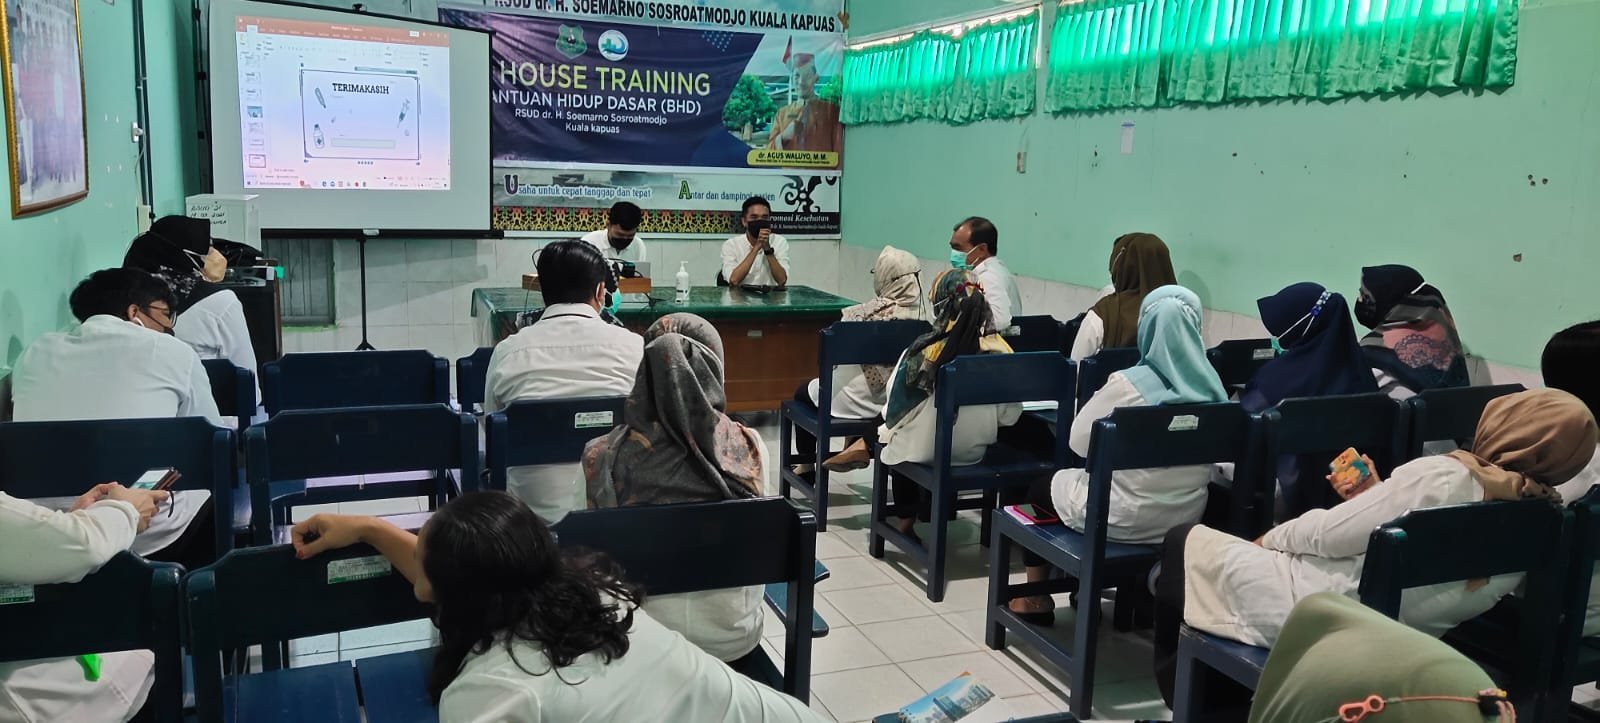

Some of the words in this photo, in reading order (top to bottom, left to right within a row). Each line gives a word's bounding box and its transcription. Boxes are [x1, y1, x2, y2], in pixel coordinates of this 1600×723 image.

[556, 0, 569, 12] H.
[573, 0, 645, 19] SOEMARNO
[649, 2, 746, 26] SOSROATMODJO
[750, 10, 788, 29] KUALA
[791, 14, 835, 33] KAPUAS
[500, 60, 588, 89] HOUSE
[595, 66, 710, 96] TRAINING
[332, 82, 390, 95] TERIMAKASIH
[492, 90, 552, 106] ANTUAN
[557, 93, 603, 109] HIDUP
[607, 96, 657, 112] DASAR
[661, 98, 702, 116] (BHD)
[515, 108, 540, 118] RSUD
[542, 110, 553, 119] dr.
[566, 111, 609, 122] Soemarno
[611, 113, 668, 126] Sosroatmodjo
[565, 122, 589, 132] Kuala
[591, 124, 620, 134] kapuas
[538, 186, 560, 195] untuk
[562, 187, 582, 197] cepat
[584, 187, 615, 198] tanggap
[617, 187, 631, 197] dan
[632, 189, 651, 198] tepat
[706, 191, 719, 200] dan
